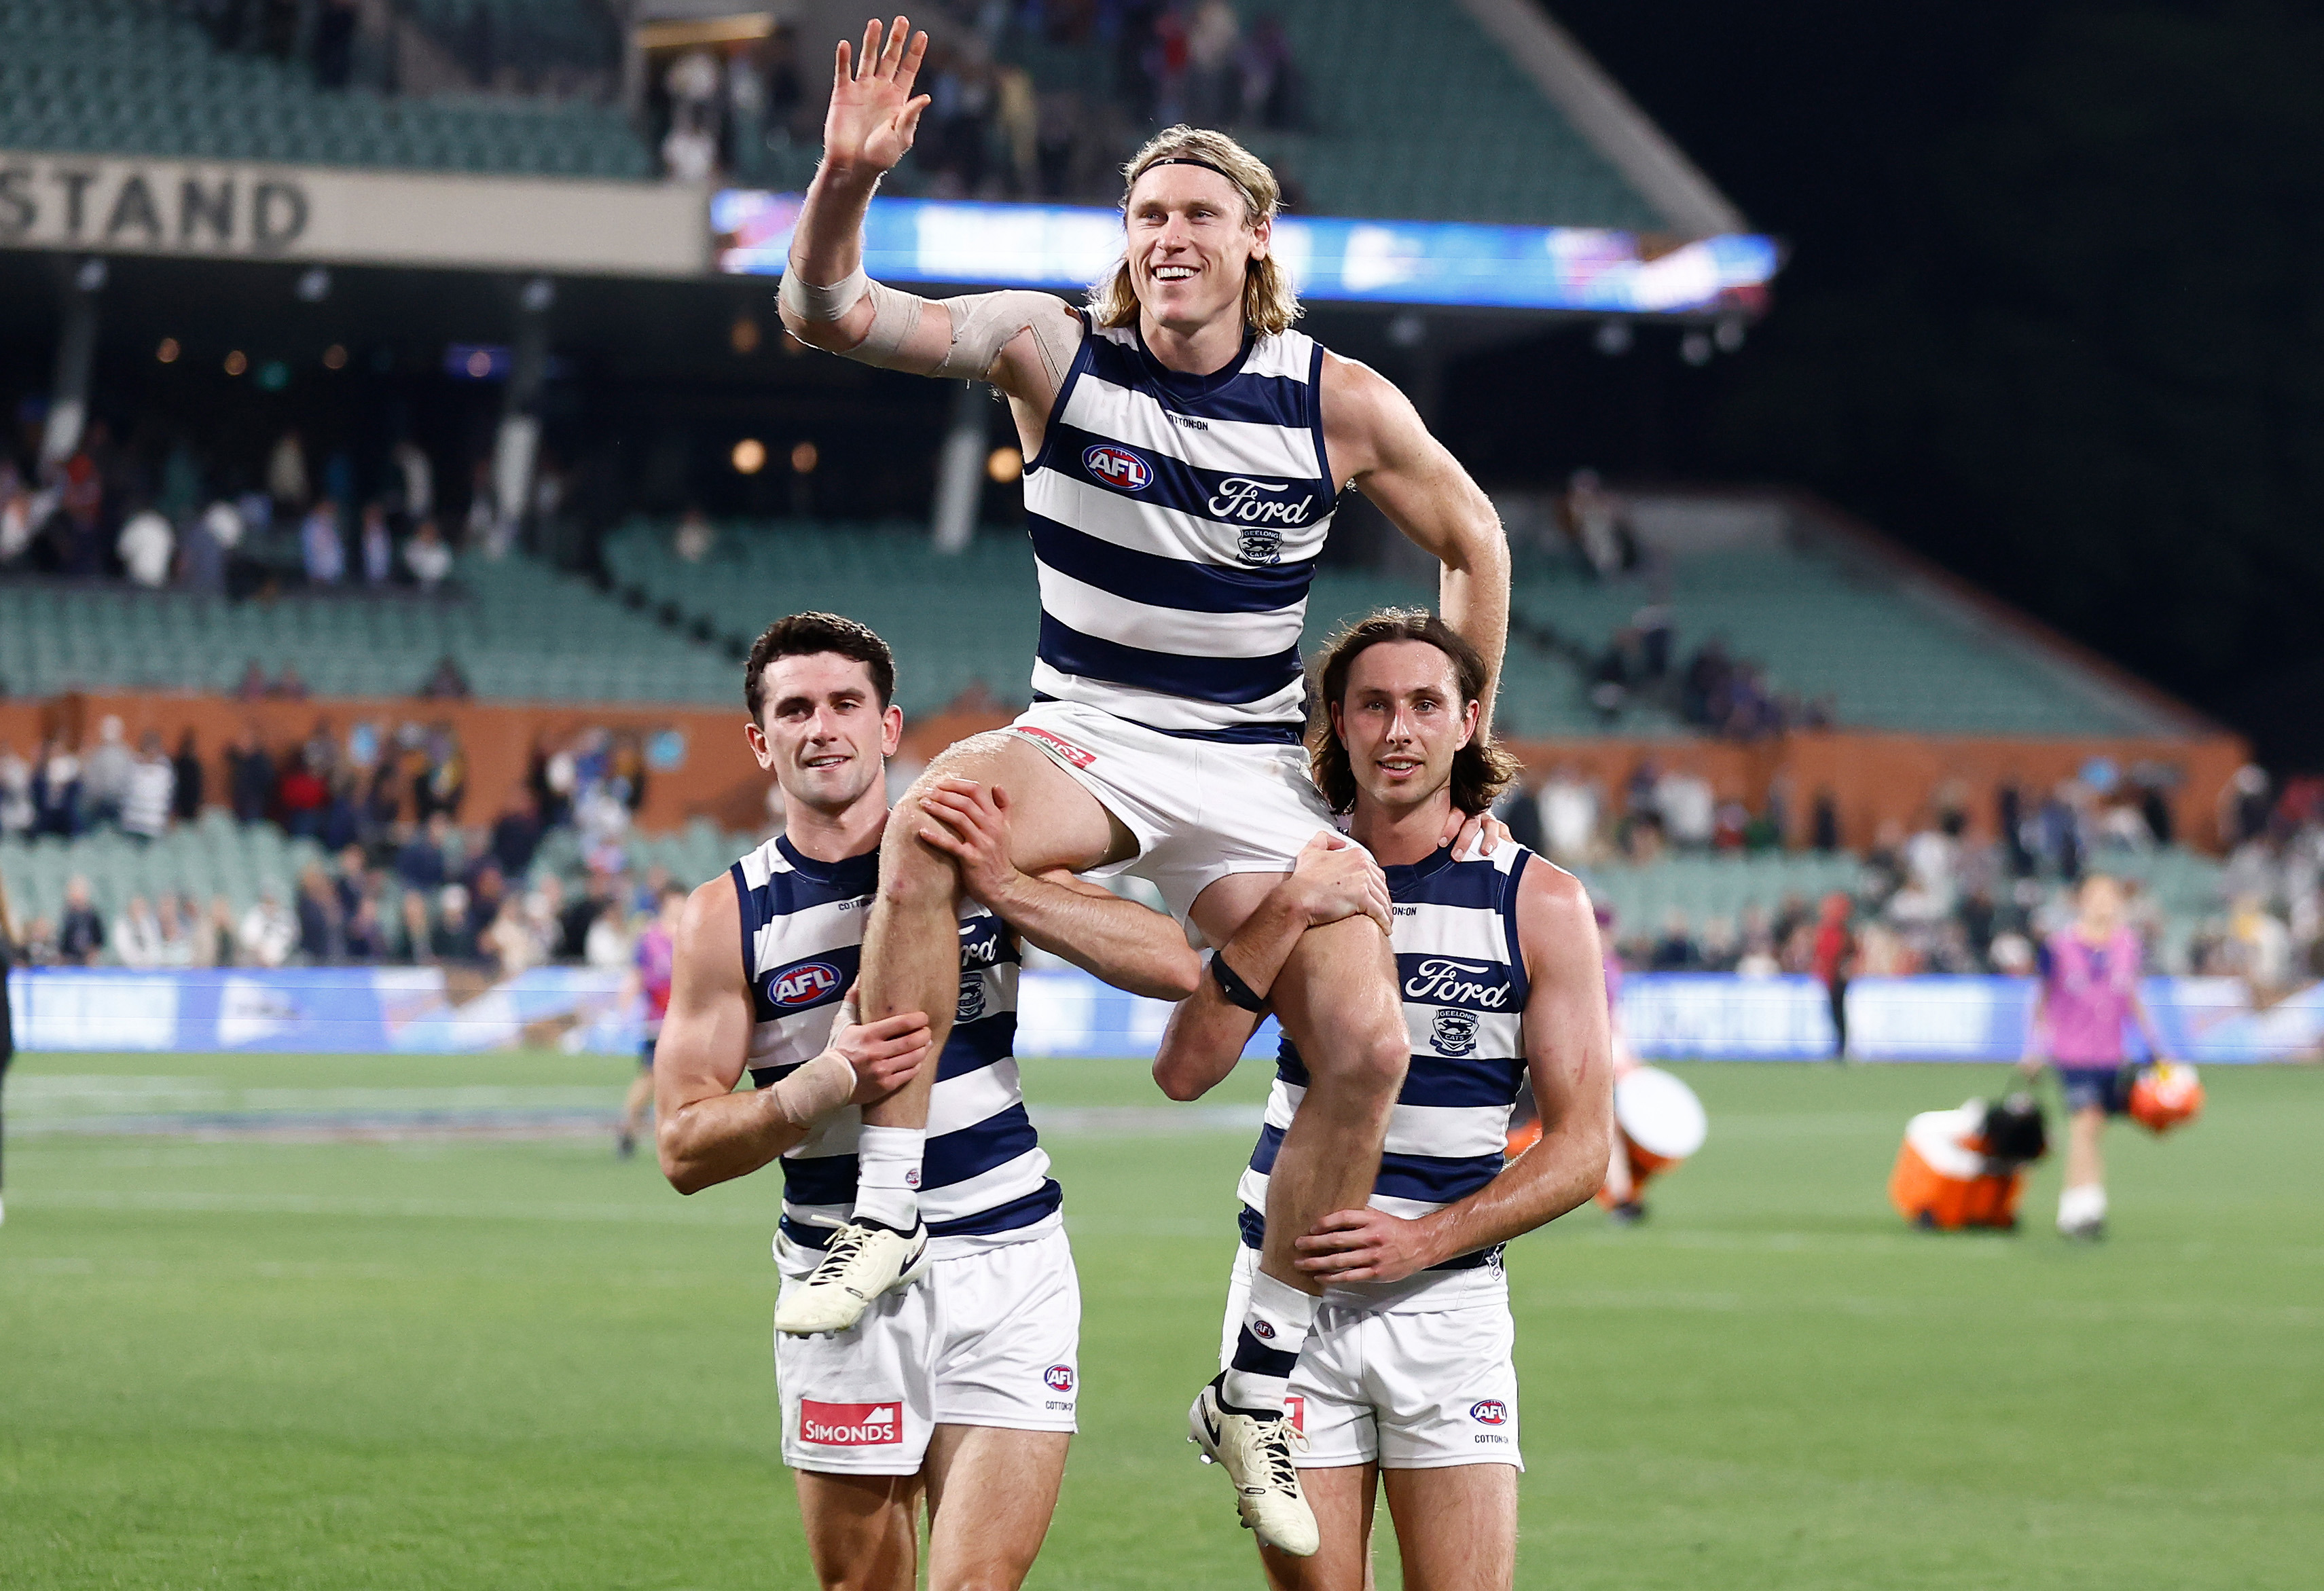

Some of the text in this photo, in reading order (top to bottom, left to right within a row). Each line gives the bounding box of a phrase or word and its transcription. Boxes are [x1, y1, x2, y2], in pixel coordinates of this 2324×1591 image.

[1167, 414, 1208, 431] OTTON:ON
[1089, 452, 1145, 485] AFL
[1208, 477, 1313, 524] Ford
[1244, 530, 1279, 538] GEELONG
[776, 969, 836, 1002] AFL
[1405, 959, 1510, 1008] Ford
[1440, 1010, 1474, 1021] GEELONG
[1256, 1323, 1273, 1336] AFL
[1047, 1370, 1073, 1386] AFL
[1474, 1405, 1506, 1421] AFL
[805, 1420, 894, 1442] SIMONDS
